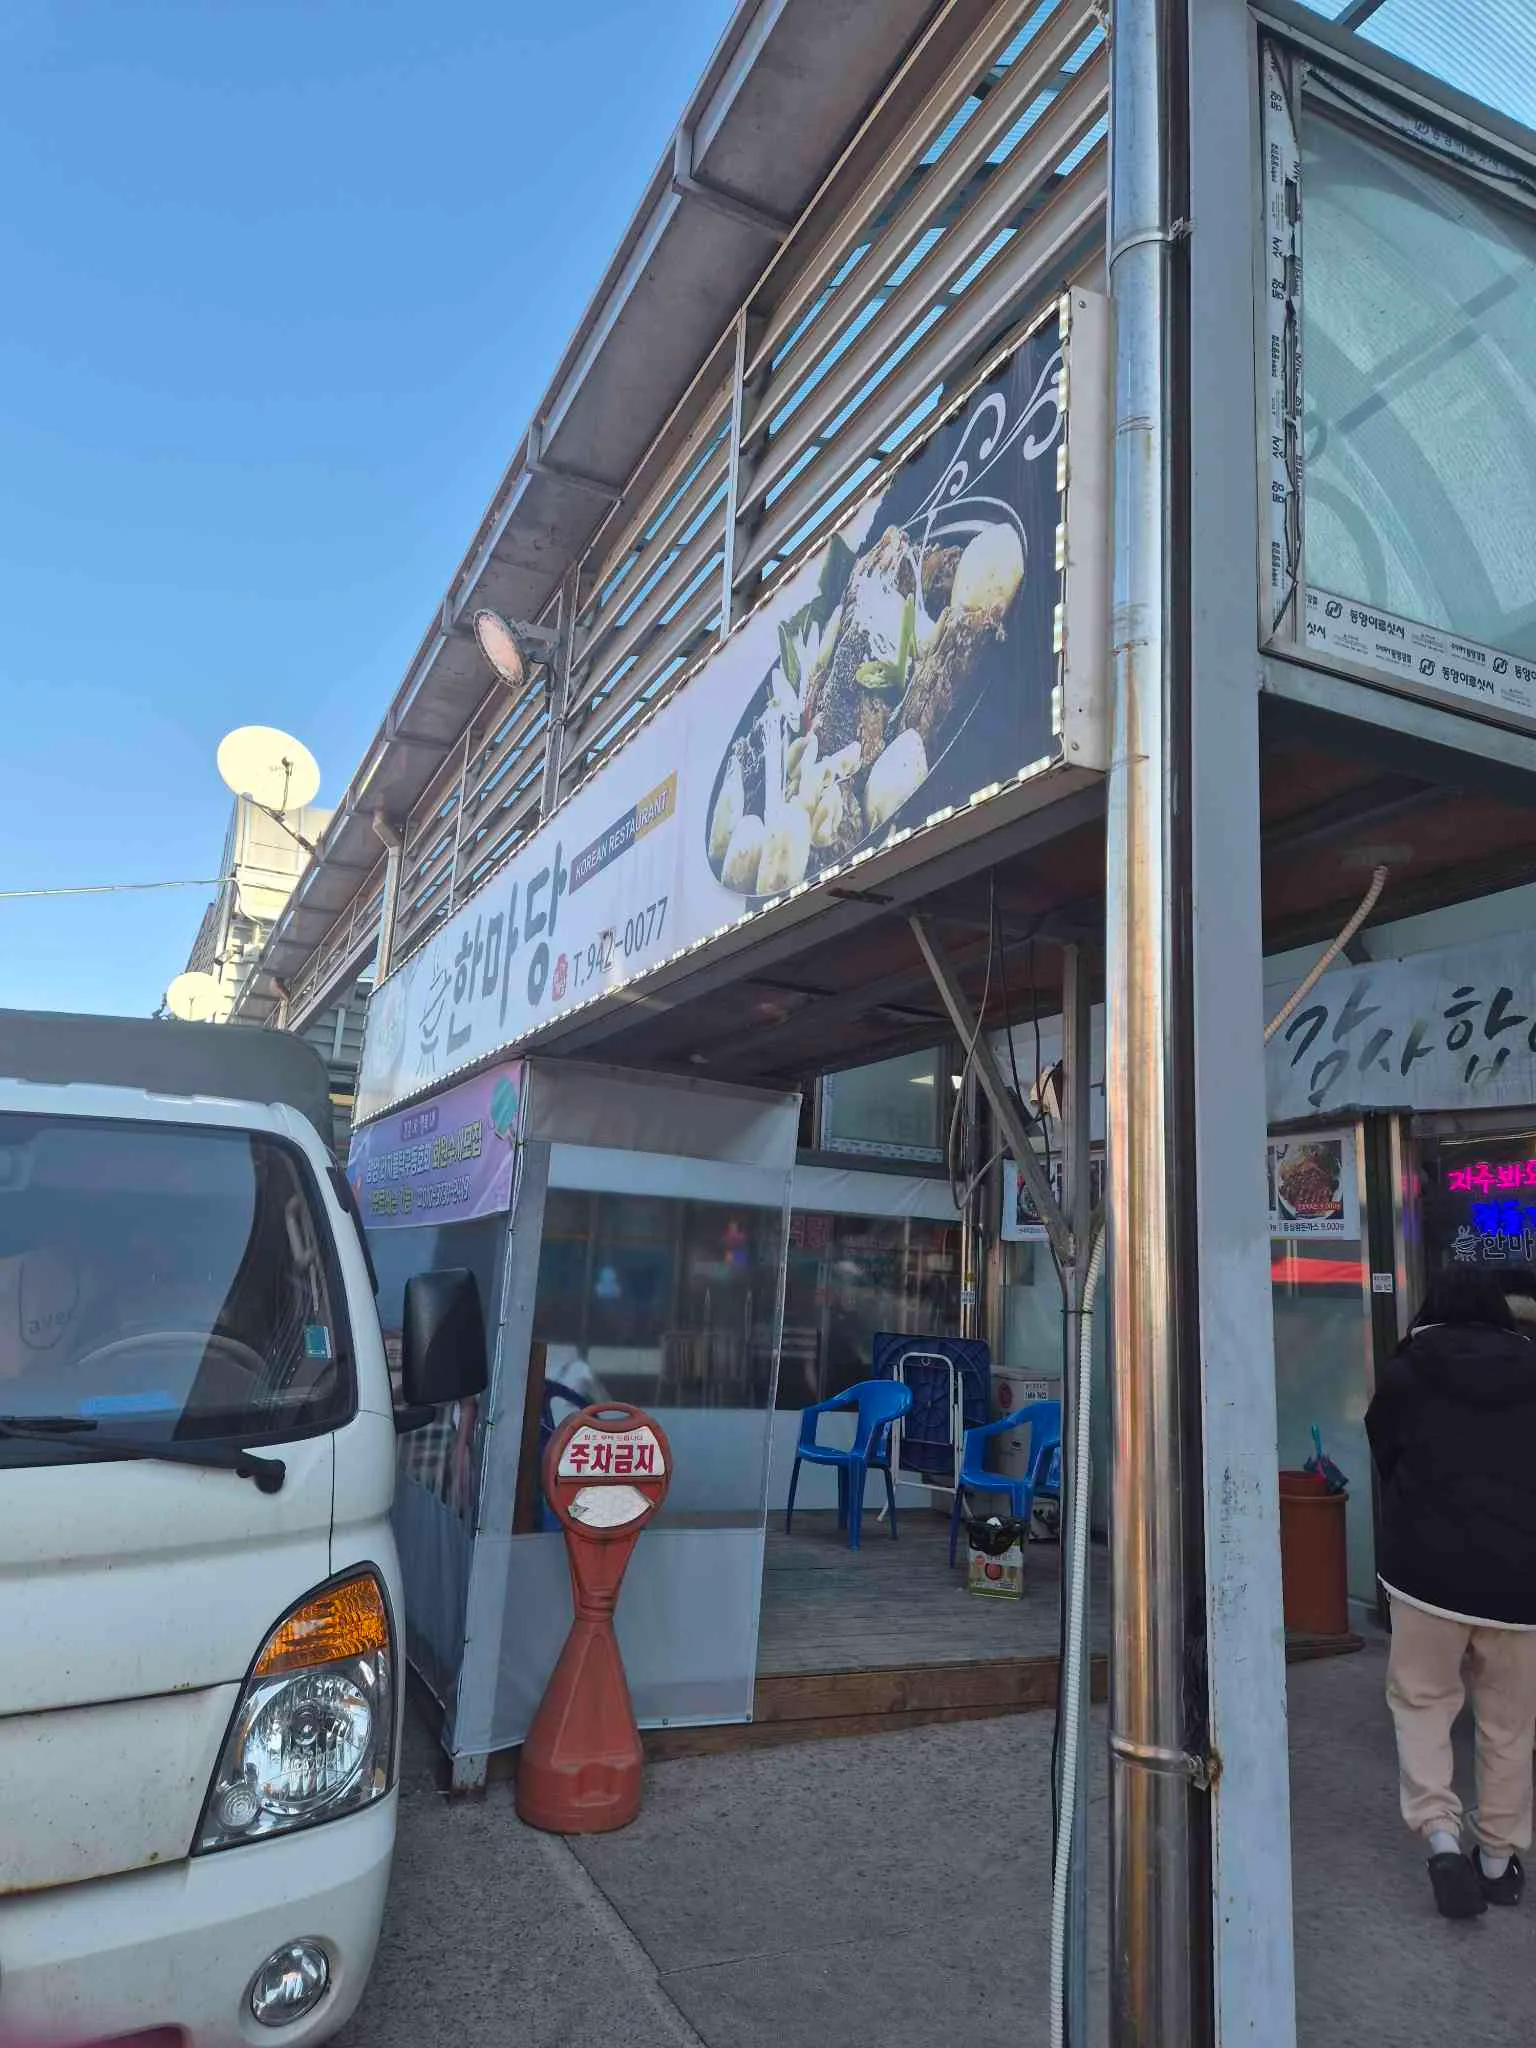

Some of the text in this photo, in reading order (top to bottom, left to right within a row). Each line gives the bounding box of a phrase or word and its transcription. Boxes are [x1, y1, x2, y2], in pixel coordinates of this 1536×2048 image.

[575, 791, 668, 880] KOREAN RESTAURANT
[446, 841, 568, 1055] 한마당
[1284, 976, 1536, 1108] 감사합
[569, 1443, 655, 1474] 주차금지
